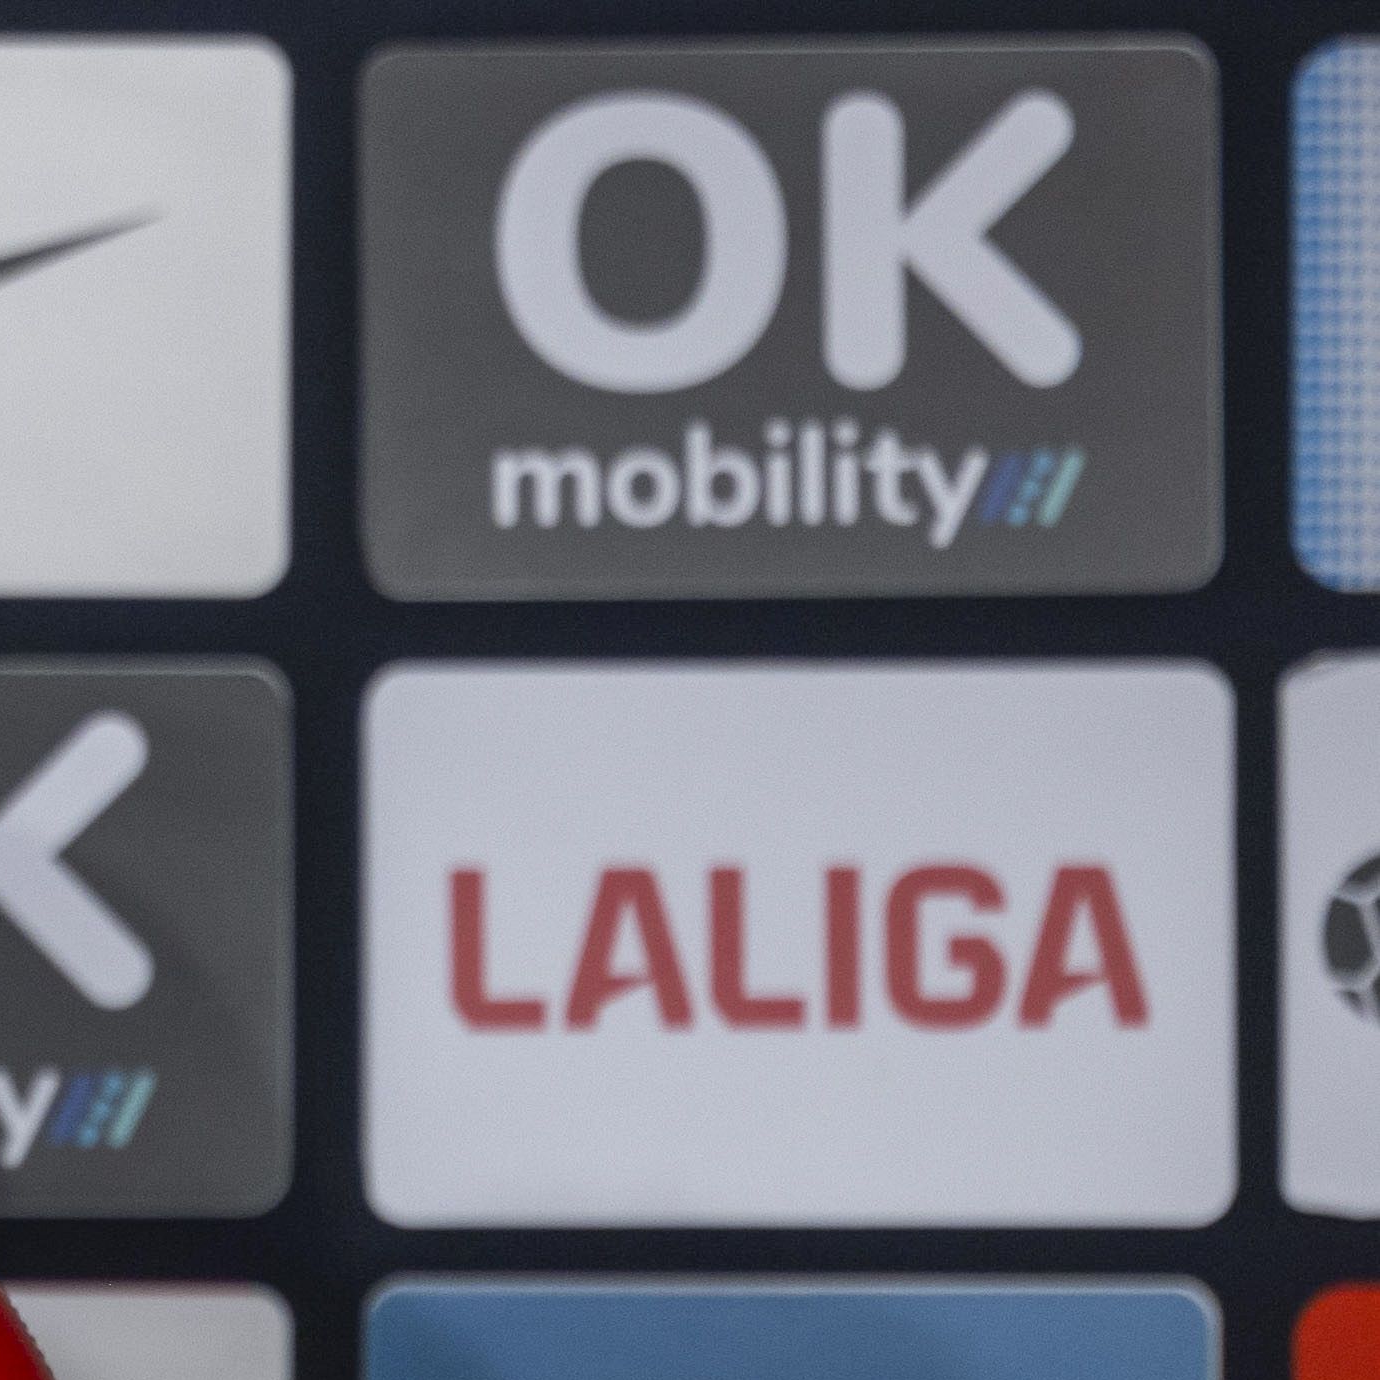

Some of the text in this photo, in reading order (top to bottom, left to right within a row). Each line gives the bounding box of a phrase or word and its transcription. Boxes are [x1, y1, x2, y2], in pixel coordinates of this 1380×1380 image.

[494, 90, 1084, 394] OK
[492, 420, 989, 550] mobility
[448, 861, 1151, 1033] LALIGA
